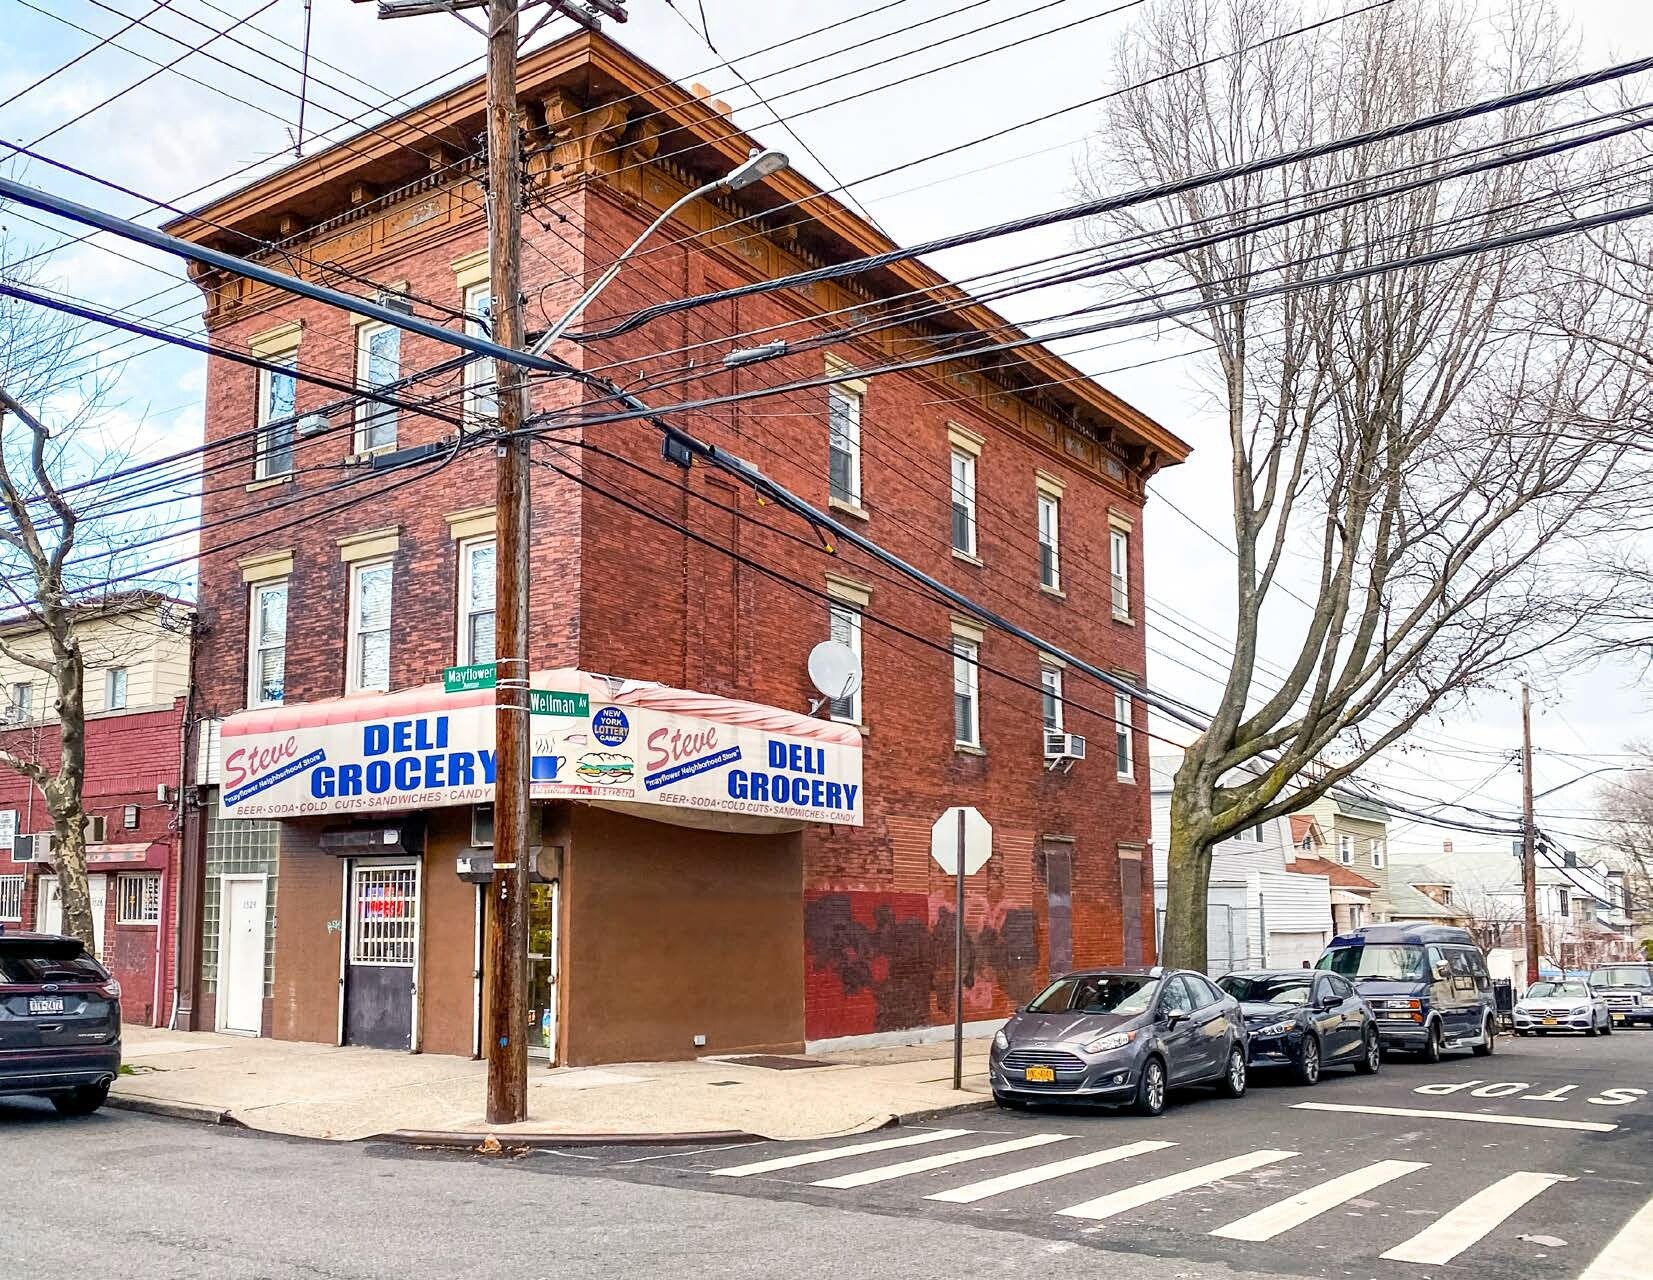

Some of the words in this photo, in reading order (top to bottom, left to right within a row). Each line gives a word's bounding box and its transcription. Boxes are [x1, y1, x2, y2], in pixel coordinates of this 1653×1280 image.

[448, 667, 492, 684] Mayflower
[530, 693, 575, 714] Wellman
[579, 697, 587, 708] Av
[594, 724, 629, 736] LOTTERY
[601, 717, 622, 726] YORK
[363, 716, 449, 757] DELI
[600, 735, 623, 743] GAMES
[646, 727, 718, 771] Steve
[225, 735, 298, 789] Steve
[681, 754, 722, 776] Neighborhood
[768, 739, 825, 776] DELI
[258, 762, 302, 788] Neighborhood
[311, 749, 496, 799] GROCERY
[236, 805, 263, 815] BEER
[267, 803, 295, 814] SODA
[299, 801, 328, 812] COLD
[335, 798, 363, 810] CUTS
[368, 791, 441, 807] SANDWICHES
[450, 788, 492, 800] CANDY
[727, 769, 858, 811] GROCERY
[659, 792, 686, 804] BEER
[690, 796, 717, 808] SODA
[721, 799, 745, 812] COLD
[747, 801, 769, 813] CUTS
[772, 805, 825, 820] SANDWICHES
[830, 812, 856, 824] CANDY
[1413, 1080, 1648, 1105] STOP
